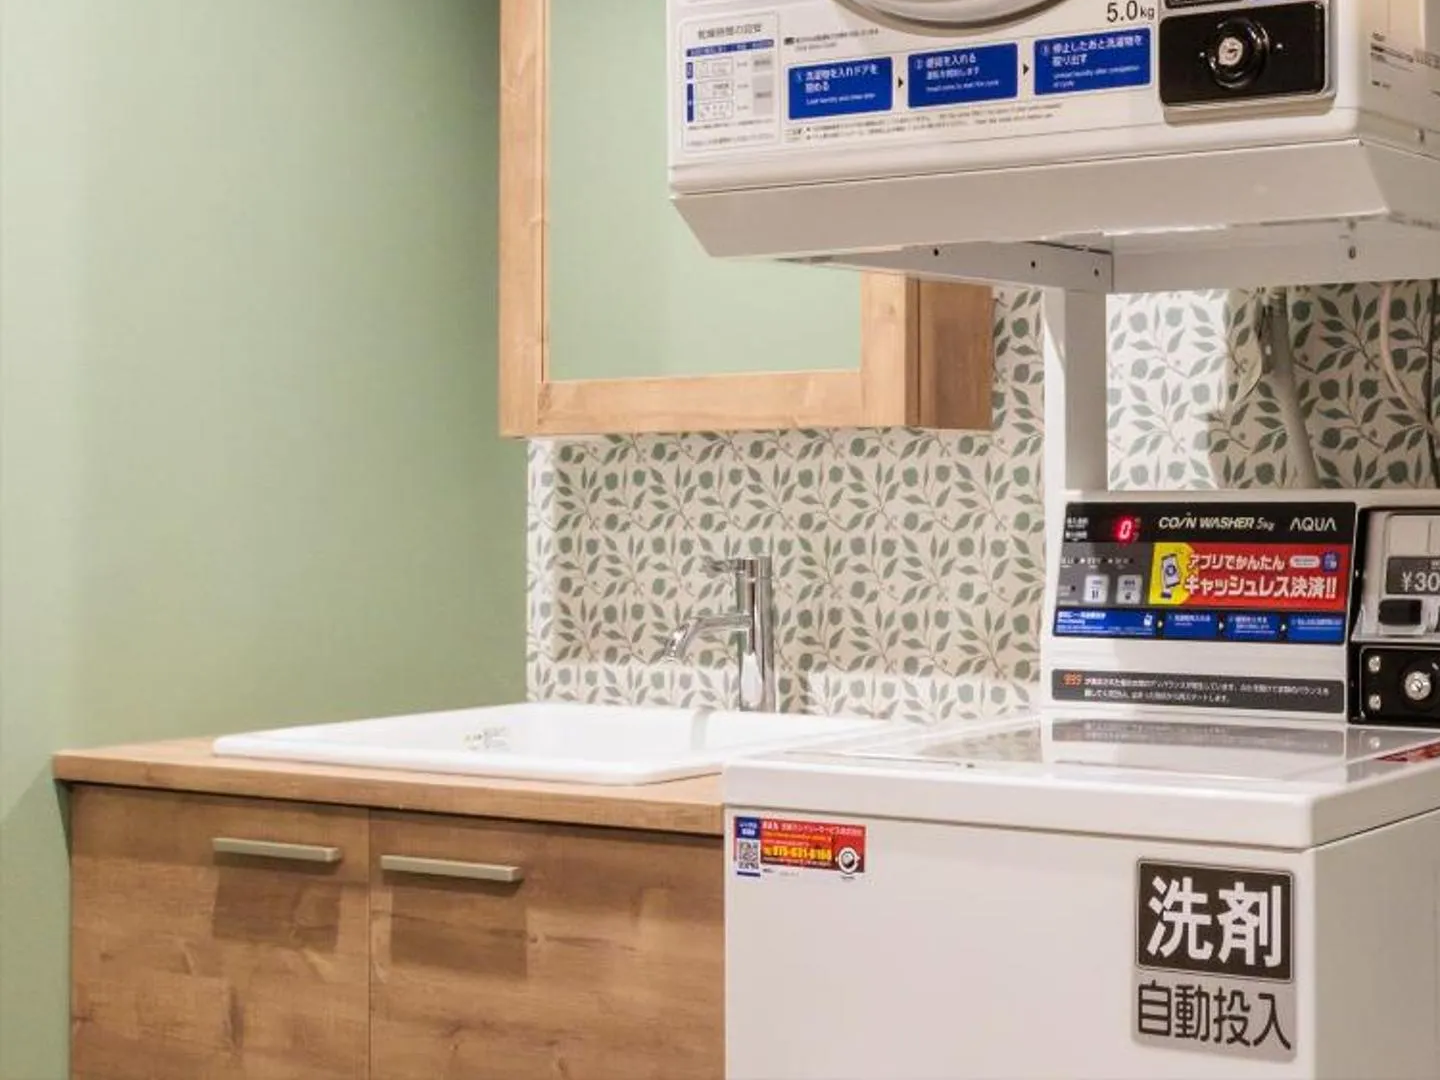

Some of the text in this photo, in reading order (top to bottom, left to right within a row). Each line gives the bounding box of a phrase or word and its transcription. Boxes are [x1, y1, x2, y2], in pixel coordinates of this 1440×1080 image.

[1119, 520, 1132, 540] 0
[1200, 516, 1255, 529] WASHER
[1290, 517, 1336, 531] AQUA
[1189, 554, 1285, 571] アプリでかんたん
[1185, 574, 1337, 600] キャッシュレス決済!!
[1147, 875, 1282, 968] 洗剤
[1138, 979, 1291, 1050] 自動投入
